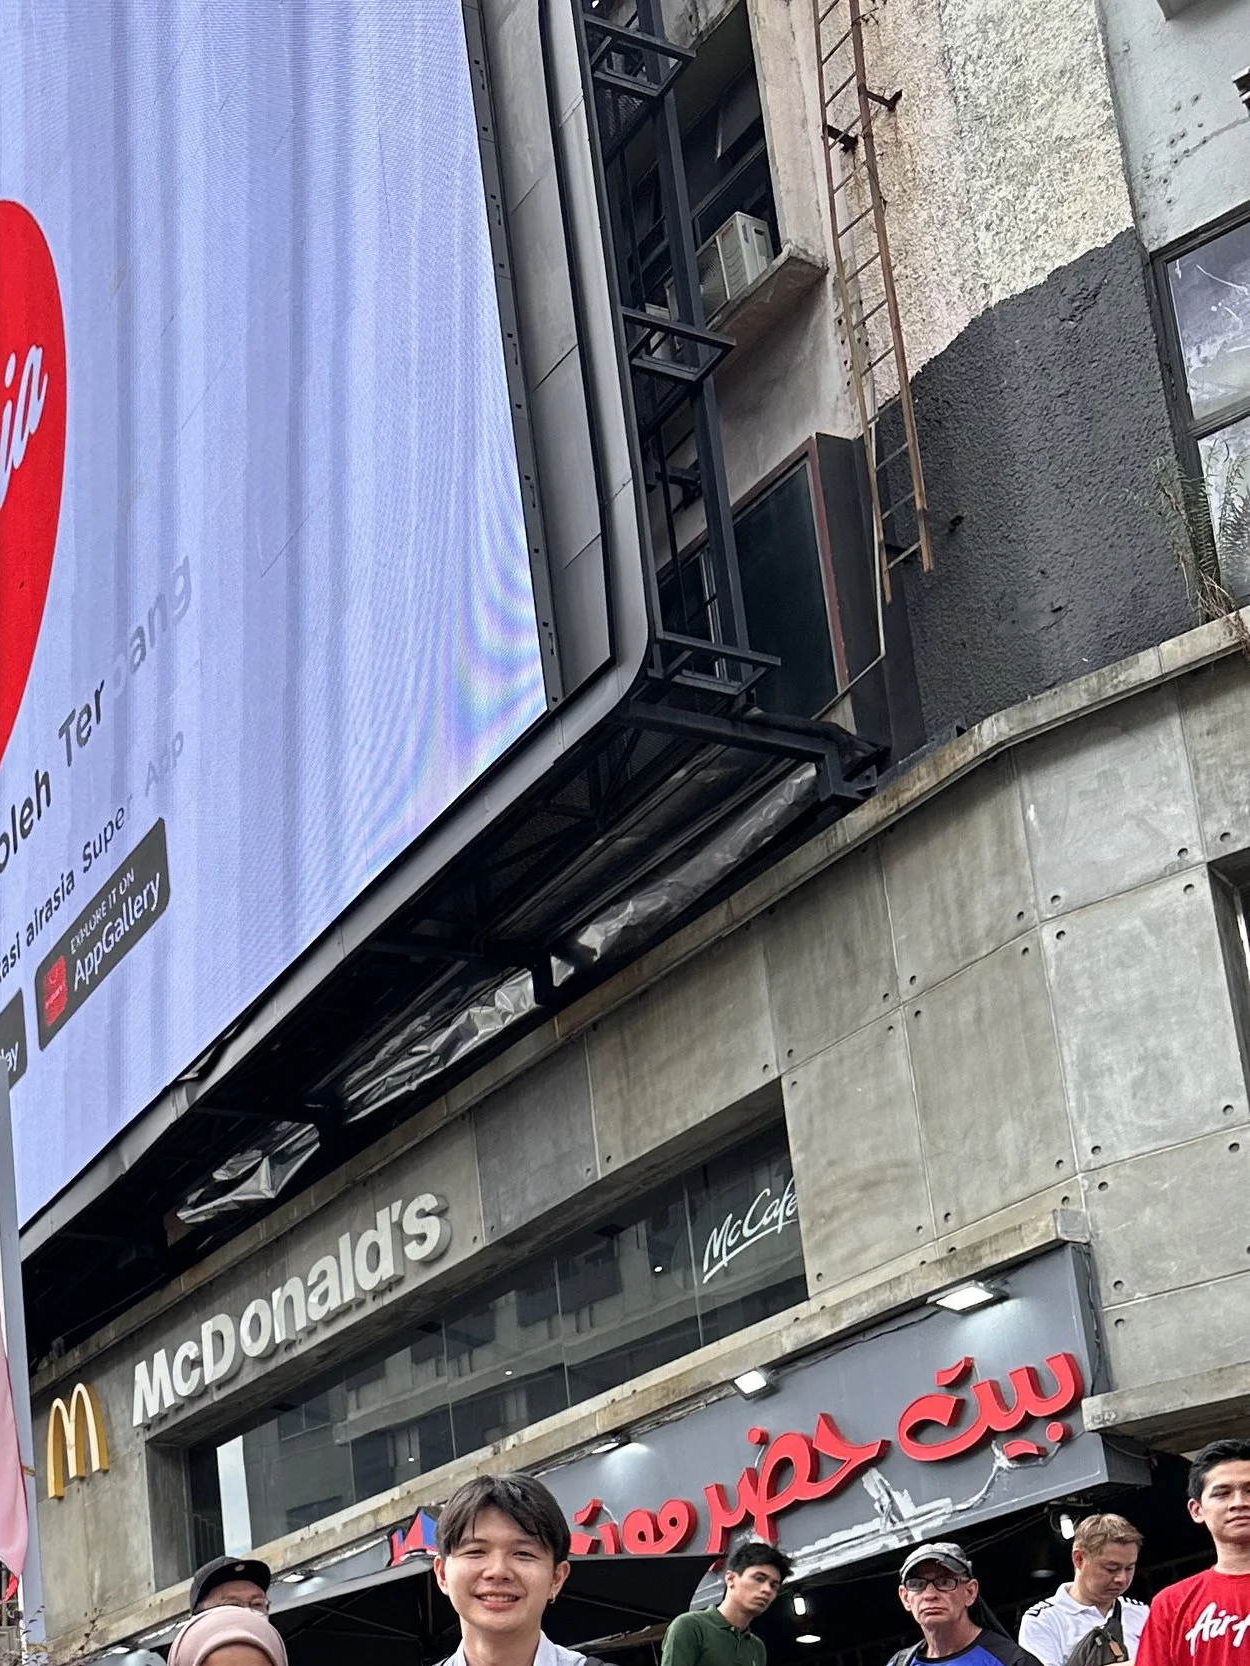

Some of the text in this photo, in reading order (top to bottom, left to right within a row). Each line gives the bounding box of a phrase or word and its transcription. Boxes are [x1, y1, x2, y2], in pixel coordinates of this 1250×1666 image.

[26, 870, 75, 946] airasia
[70, 867, 135, 955] EXPLORE IT ON
[73, 872, 160, 992] AppGallery
[132, 1192, 448, 1429] McDonald's
